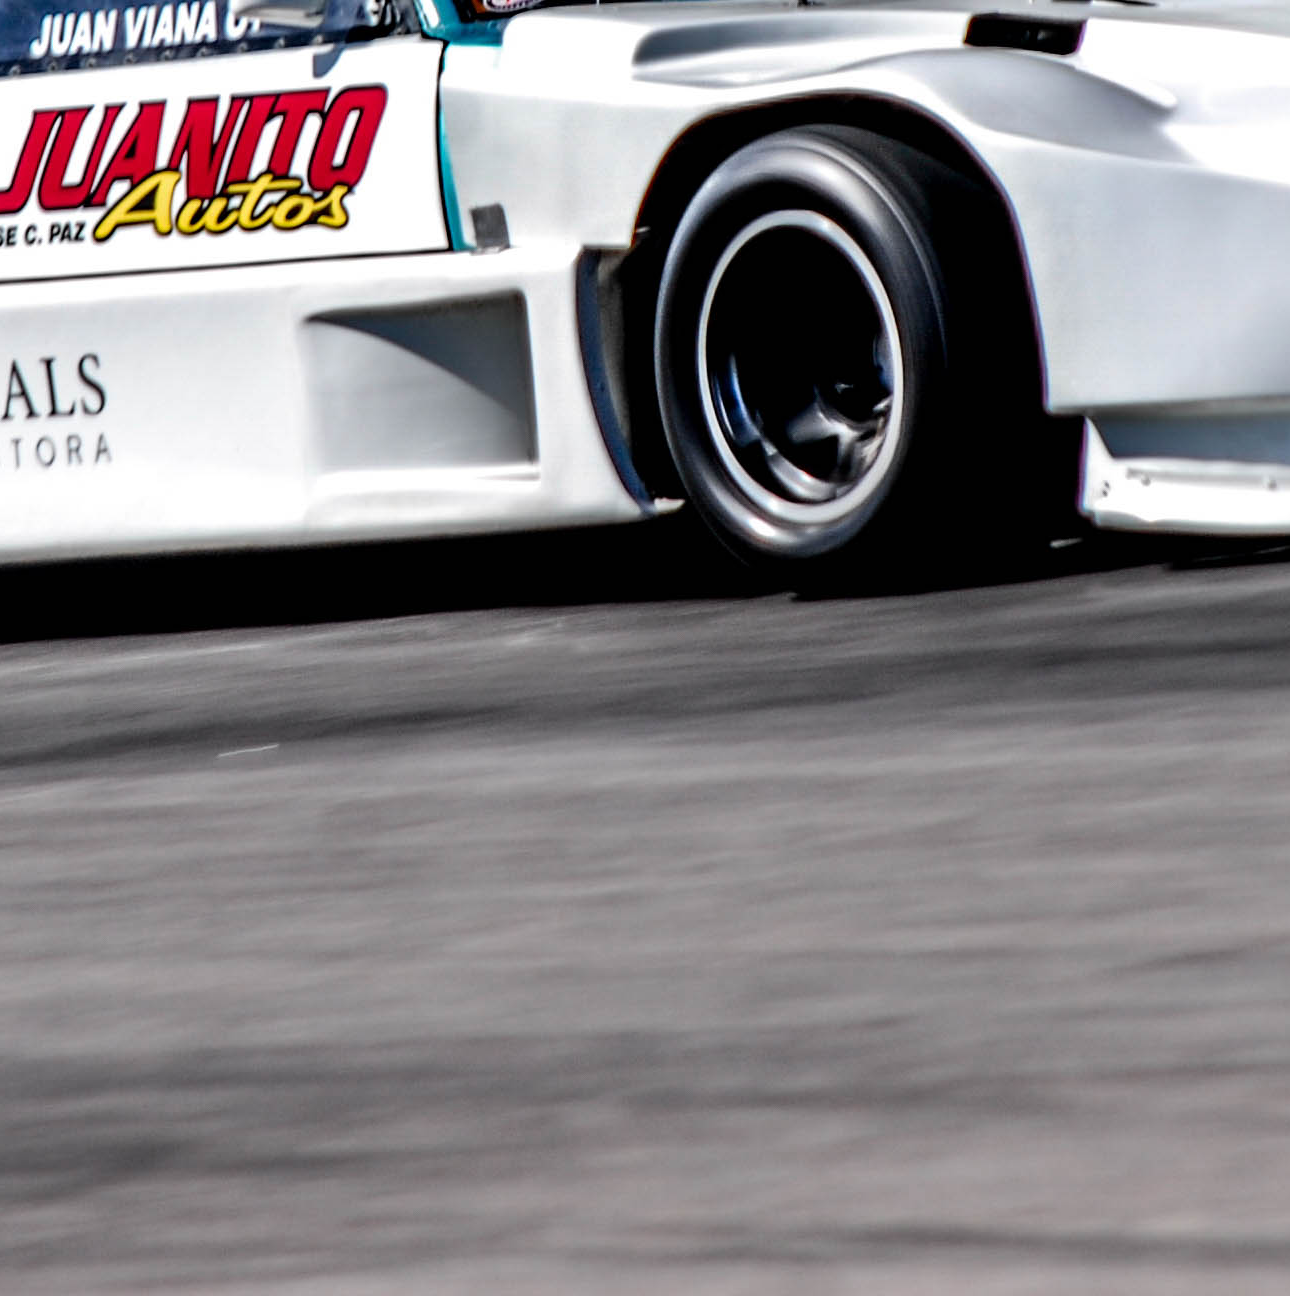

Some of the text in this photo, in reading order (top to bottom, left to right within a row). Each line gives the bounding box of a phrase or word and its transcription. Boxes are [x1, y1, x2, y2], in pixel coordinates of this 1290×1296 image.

[29, 12, 118, 60] JUAN
[123, 0, 218, 48] VIANA
[24, 223, 42, 246] C.
[49, 220, 86, 245] PAZ
[93, 170, 351, 244] Autos
